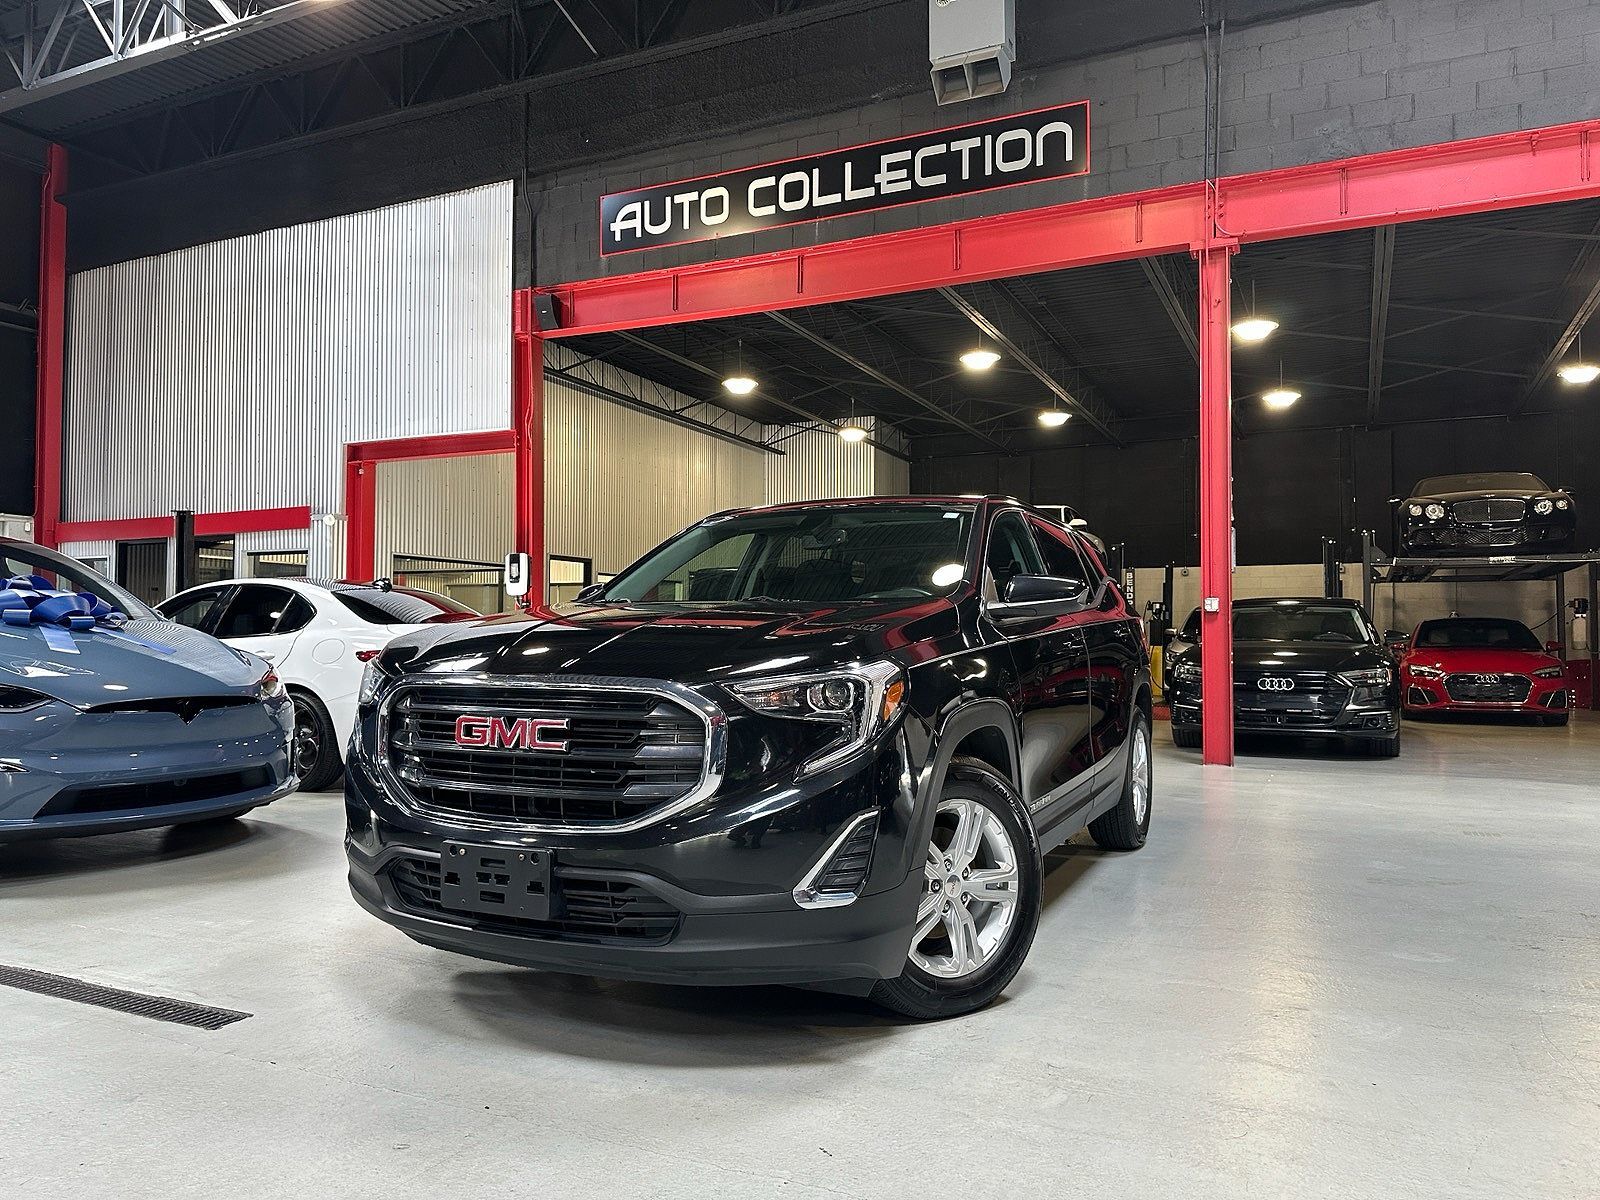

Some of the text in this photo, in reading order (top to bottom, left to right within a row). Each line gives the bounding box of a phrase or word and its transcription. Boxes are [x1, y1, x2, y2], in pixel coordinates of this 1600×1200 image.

[609, 121, 1073, 242] AUTO COLLECTION
[455, 715, 570, 752] GMC
